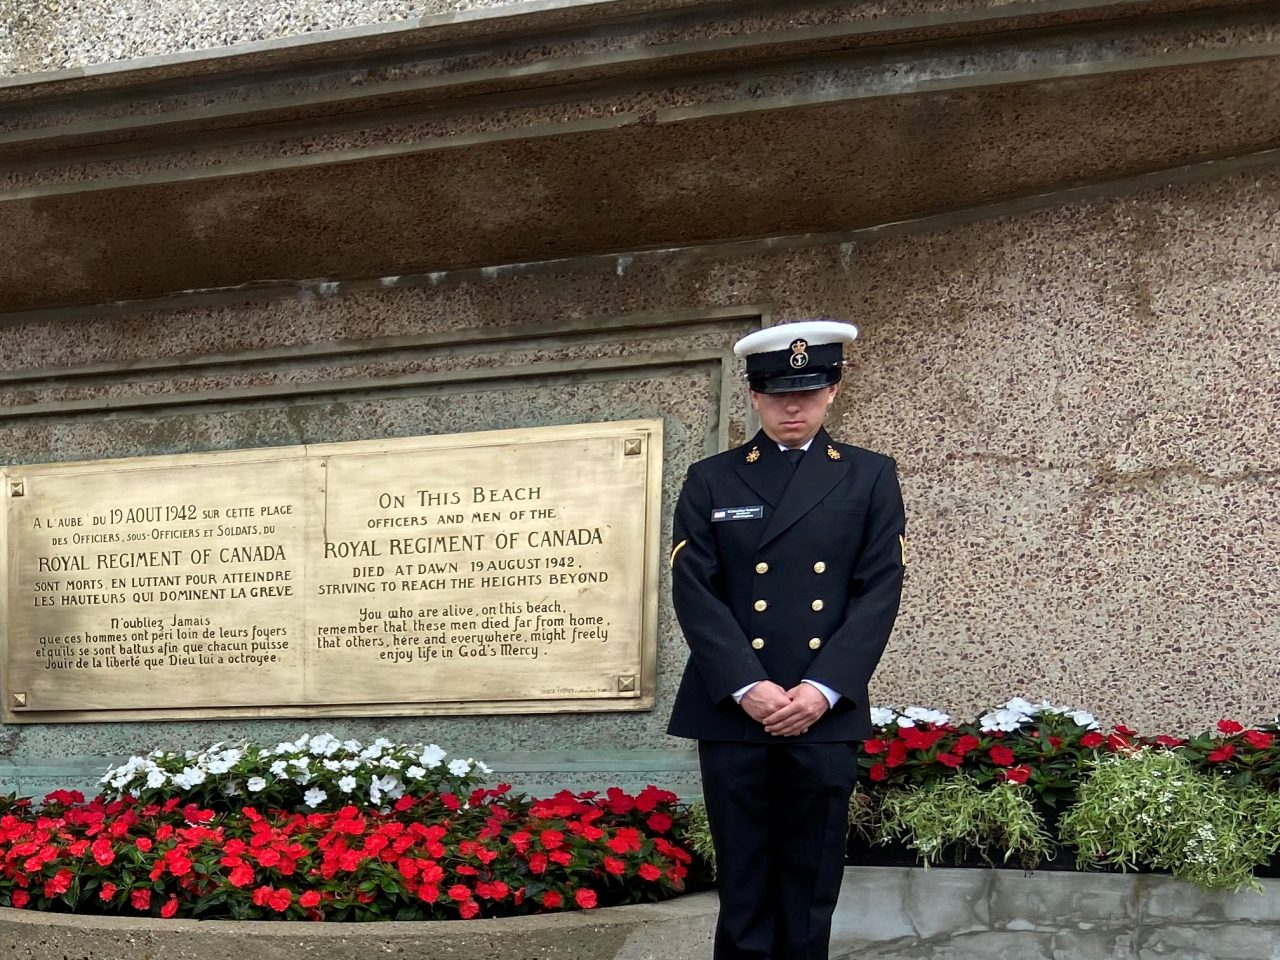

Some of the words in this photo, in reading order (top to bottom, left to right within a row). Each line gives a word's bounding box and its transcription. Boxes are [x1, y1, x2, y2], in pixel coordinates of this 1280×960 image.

[47, 517, 84, 529] L'AUBE
[92, 516, 107, 526] DU
[110, 508, 123, 525] 19
[125, 506, 162, 524] AOUT
[165, 504, 197, 521] 1942
[202, 509, 220, 520] SUR
[226, 507, 255, 518] CETTE
[260, 504, 293, 517] PLAGE
[367, 516, 428, 529] OFFICERS
[437, 514, 464, 525] AND
[472, 511, 501, 523] MEN
[509, 510, 526, 521] OF
[530, 508, 557, 519] THE
[52, 537, 68, 546] DES
[203, 529, 214, 538] ET
[263, 525, 275, 535] DU
[324, 540, 382, 558] ROYAL
[389, 534, 485, 555] REGIMENT
[495, 532, 520, 550] OF
[527, 527, 604, 548] CANADA
[38, 555, 91, 572] ROYAL
[96, 550, 182, 569] REGIMENT
[190, 548, 212, 565] OF
[220, 544, 286, 563] CANADA
[352, 566, 385, 578] DIED
[394, 564, 414, 576] AT
[417, 562, 459, 575] DAWN
[470, 561, 484, 572] 19
[486, 558, 541, 571] AUGUST
[33, 581, 60, 592] SONT
[111, 578, 126, 589] EN
[131, 575, 181, 587] LUTTANT
[185, 574, 217, 586] POUR
[222, 570, 293, 584] ATTEINDRE
[317, 582, 376, 595] STRIVING
[380, 581, 397, 592] TO
[401, 578, 446, 591] REACH
[450, 577, 476, 589] THE
[481, 574, 542, 588] HEIGHTS
[549, 571, 609, 585] BEYOND
[34, 596, 55, 607] LES
[61, 593, 126, 606] HAUTEURS
[132, 591, 154, 603] QUI
[159, 588, 227, 602] DOMINENT
[230, 587, 247, 599] LA
[250, 585, 294, 598] GREVE
[170, 614, 211, 627] Jamais
[359, 607, 382, 621] You
[388, 606, 414, 619] who
[418, 607, 439, 618] are
[481, 605, 497, 616] on
[499, 601, 523, 615] this
[317, 621, 379, 635] remember
[383, 620, 408, 633] that
[413, 619, 446, 632] these
[450, 620, 477, 631] men
[481, 616, 510, 630] died
[513, 615, 533, 632] far
[535, 614, 564, 632] from
[39, 636, 61, 647] que
[64, 635, 82, 644] ces
[85, 631, 127, 643] hommes
[131, 629, 149, 641] ont
[151, 629, 173, 644] péri
[176, 628, 198, 639] loin
[202, 628, 216, 639] de
[219, 627, 249, 638] leurs
[252, 625, 287, 641] foyers
[317, 636, 341, 649] that
[393, 633, 420, 647] here
[423, 632, 447, 645] and
[530, 627, 567, 645] might
[570, 626, 609, 643] freely
[79, 648, 90, 656] se
[93, 645, 116, 655] sont
[119, 643, 155, 655] battus
[157, 641, 178, 656] afin
[183, 644, 203, 655] que
[207, 640, 248, 652] chacun
[251, 639, 289, 653] puisse
[379, 647, 413, 663] enjoy
[418, 645, 438, 662] life
[441, 645, 453, 658] in
[458, 643, 497, 657] God's
[45, 657, 74, 669] Jouir
[76, 657, 89, 669] de
[92, 657, 102, 668] la
[106, 655, 140, 668] liberté
[144, 657, 164, 670] que
[169, 654, 196, 666] Dieu
[199, 653, 214, 665] lui
[217, 656, 224, 664] a
